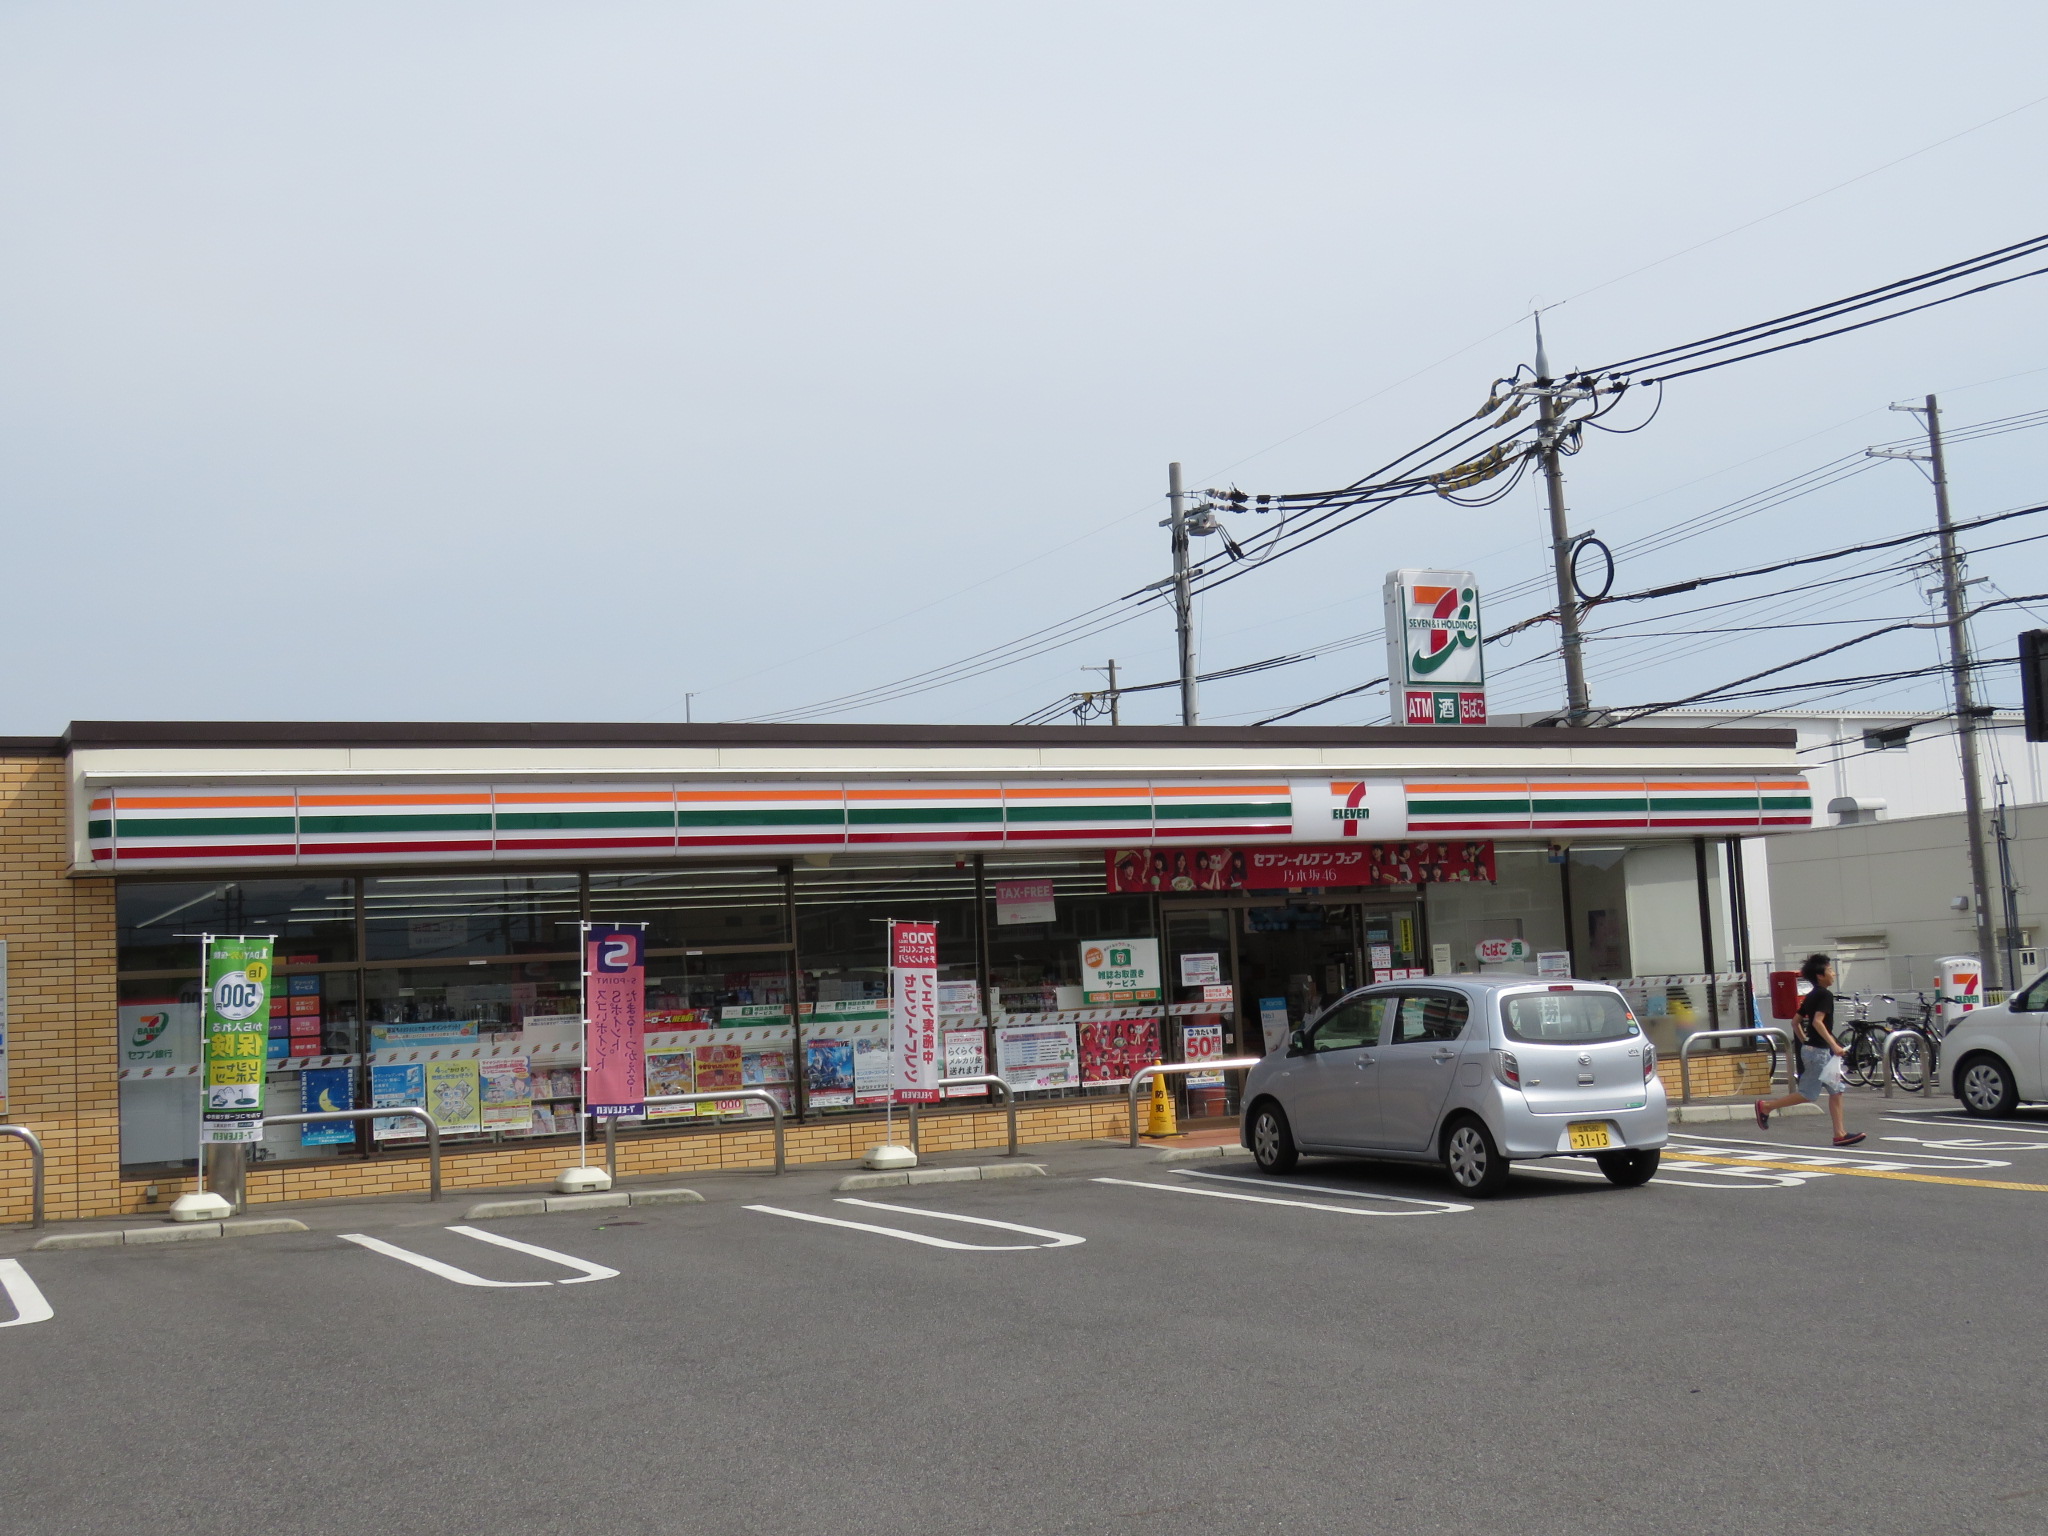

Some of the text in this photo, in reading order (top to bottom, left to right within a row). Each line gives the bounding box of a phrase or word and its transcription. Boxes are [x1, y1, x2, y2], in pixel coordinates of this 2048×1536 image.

[1441, 620, 1477, 630] HOLDINGS
[1409, 698, 1432, 718] ATM
[1438, 698, 1455, 719] 酒
[1461, 699, 1485, 718] たばこ
[999, 886, 1050, 899] TAX-FREE
[1481, 943, 1507, 957] たばこ
[1511, 942, 1523, 956] 酒
[1098, 969, 1145, 980] 雑誌お取置き
[1106, 980, 1137, 988] サービス
[128, 1049, 173, 1060] セブン銀行
[948, 1045, 973, 1056] らくらく
[949, 1056, 983, 1066] メルカリ便
[1154, 1090, 1165, 1112] 防犯
